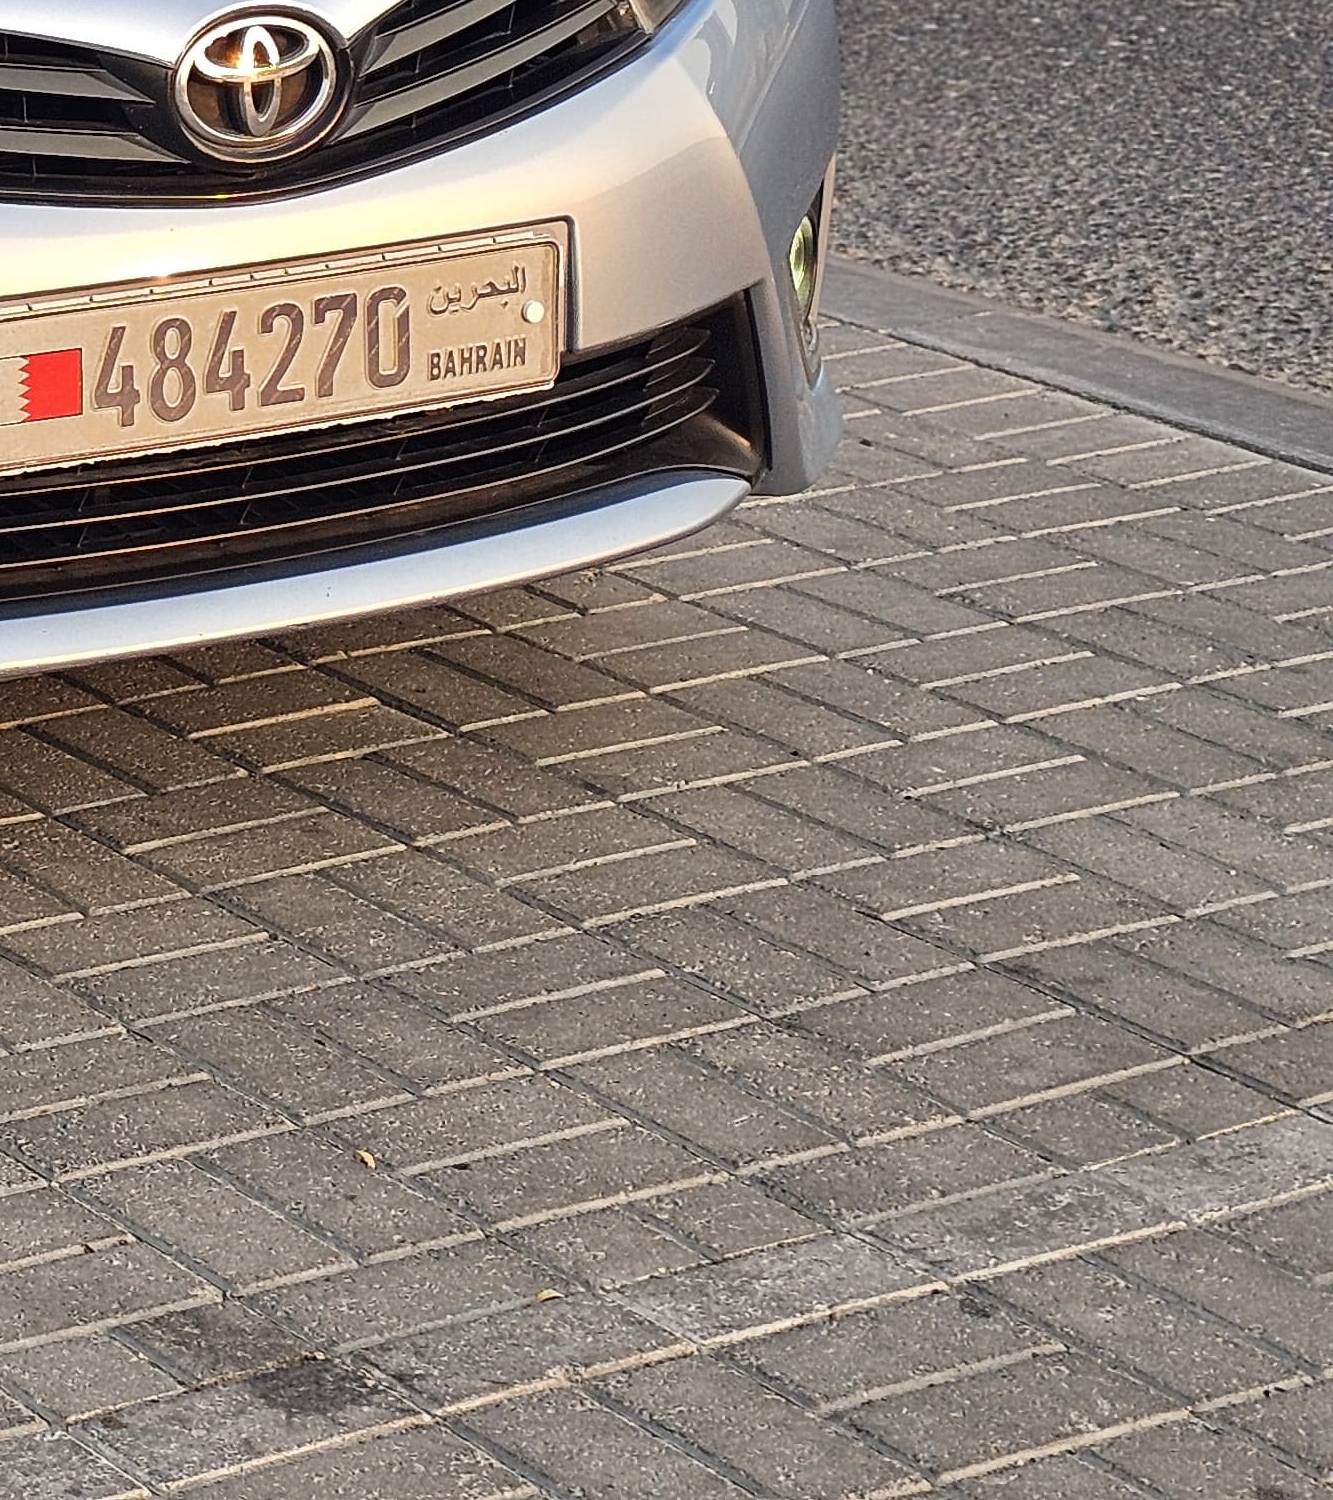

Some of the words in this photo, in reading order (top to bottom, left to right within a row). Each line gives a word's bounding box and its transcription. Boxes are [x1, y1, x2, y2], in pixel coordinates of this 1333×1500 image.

[428, 264, 527, 316] البحرين
[93, 286, 411, 428] 484270
[428, 336, 527, 381] BAHRAIN
